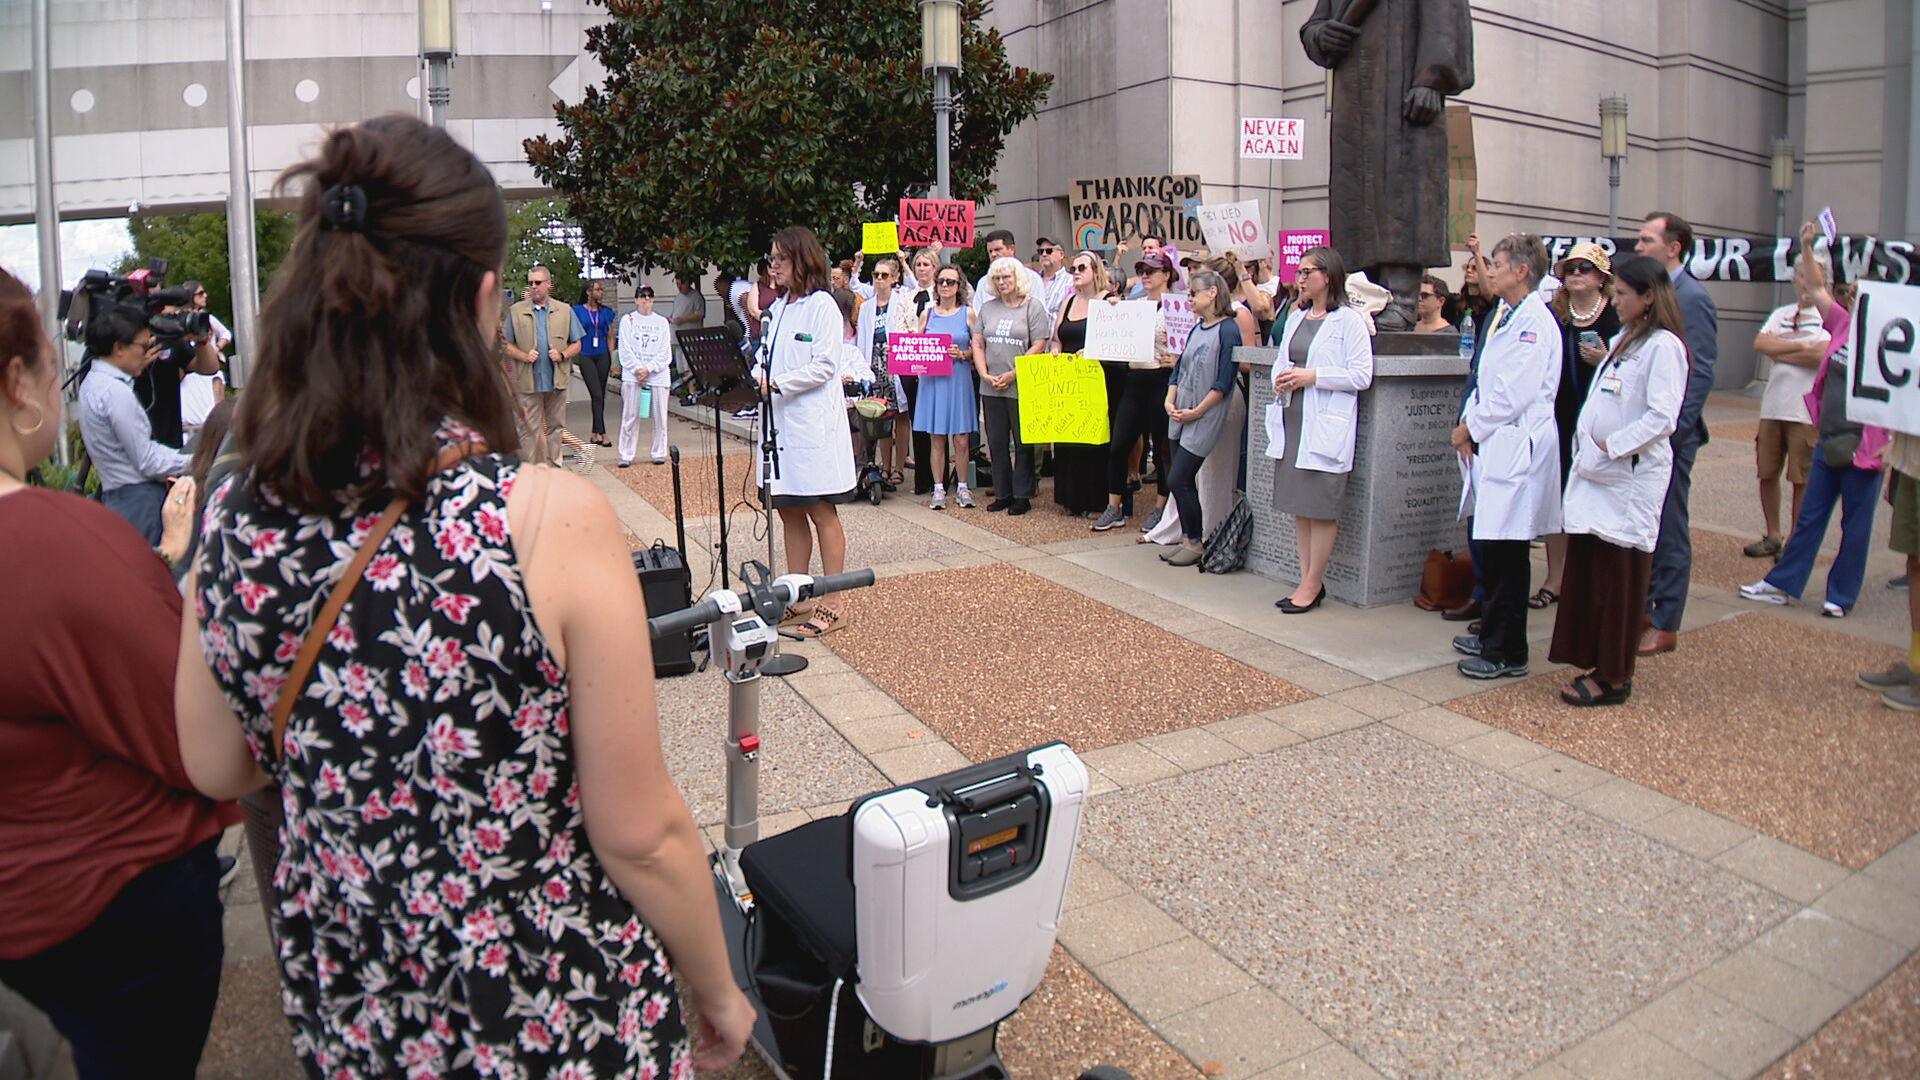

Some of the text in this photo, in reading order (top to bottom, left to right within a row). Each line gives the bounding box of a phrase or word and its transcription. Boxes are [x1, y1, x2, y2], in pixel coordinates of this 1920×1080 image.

[1244, 120, 1297, 136] NEVER
[1244, 139, 1298, 154] AGAIN
[1076, 177, 1156, 200] THANK
[906, 202, 967, 223] NEVER
[1073, 202, 1104, 221] FOR
[903, 225, 967, 244] AGAIN
[1227, 220, 1258, 245] NO
[1287, 235, 1323, 245] PROTECT
[1283, 245, 1302, 256] SAFE,
[899, 337, 941, 346] PROTECT
[1005, 338, 1024, 346] VOTE
[1852, 293, 1920, 403] Le
[892, 345, 918, 354] SAFE,
[1102, 343, 1137, 356] PERIOD
[895, 354, 944, 362] ABORTION
[1048, 381, 1084, 396] UNTIL
[1410, 388, 1450, 401] Supreme
[1405, 404, 1446, 417] "JUSTICE"
